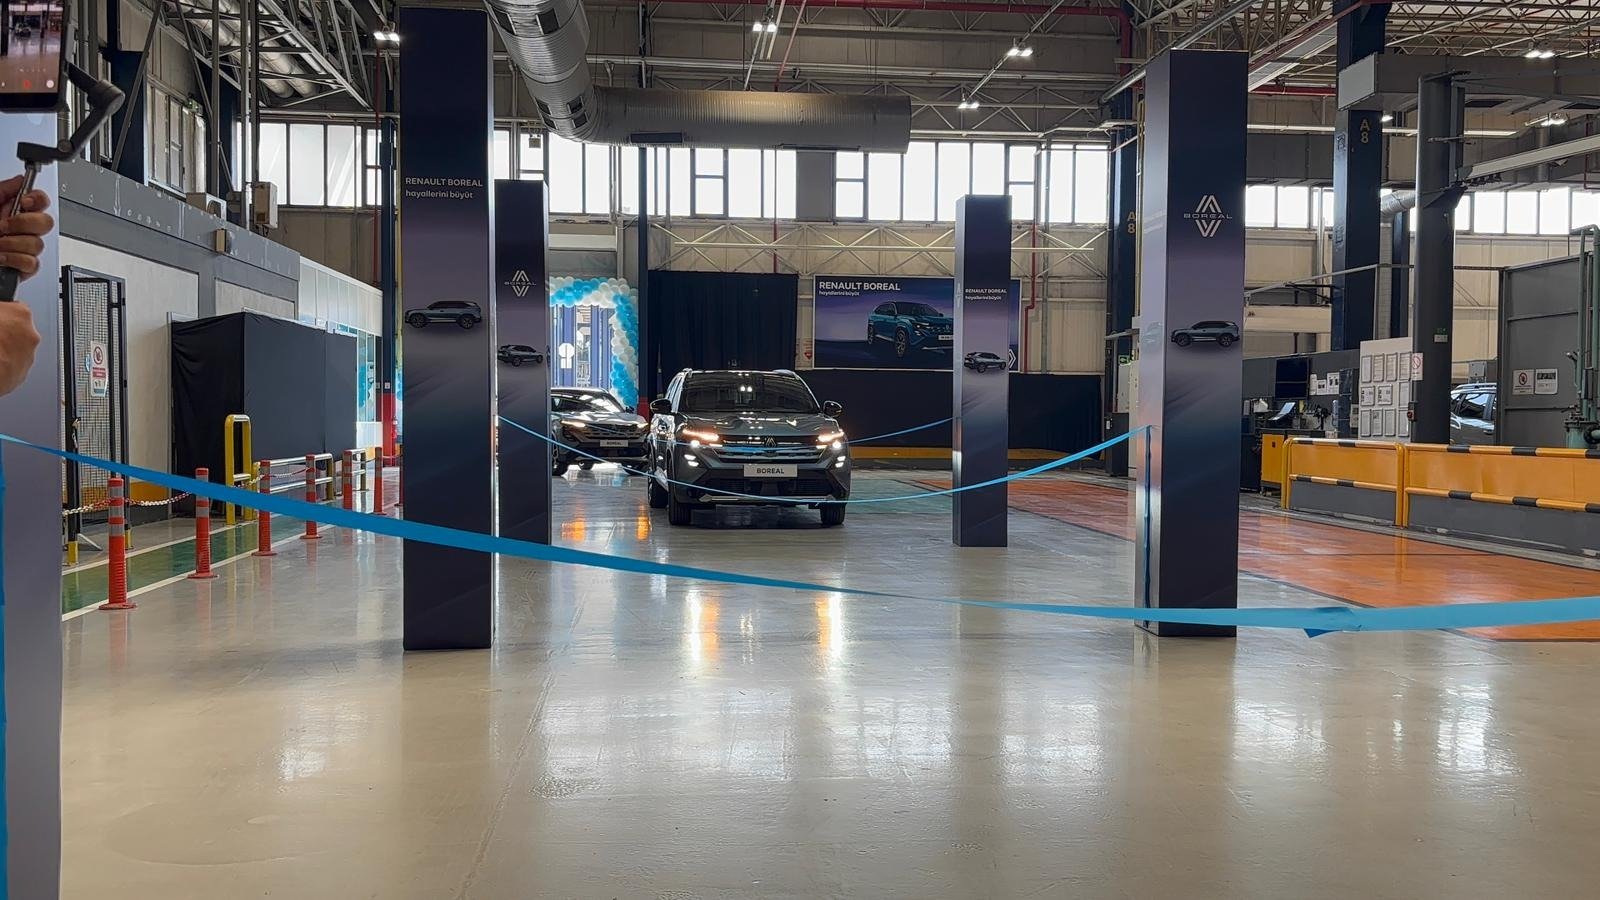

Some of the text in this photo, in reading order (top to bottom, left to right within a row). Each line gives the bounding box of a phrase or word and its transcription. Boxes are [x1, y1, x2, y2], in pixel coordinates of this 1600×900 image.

[405, 177, 483, 187] RENAULT BOREAL
[405, 190, 448, 199] hayallerini
[819, 281, 901, 291] RENAULT BOREAL
[756, 467, 785, 475] BOREAL
